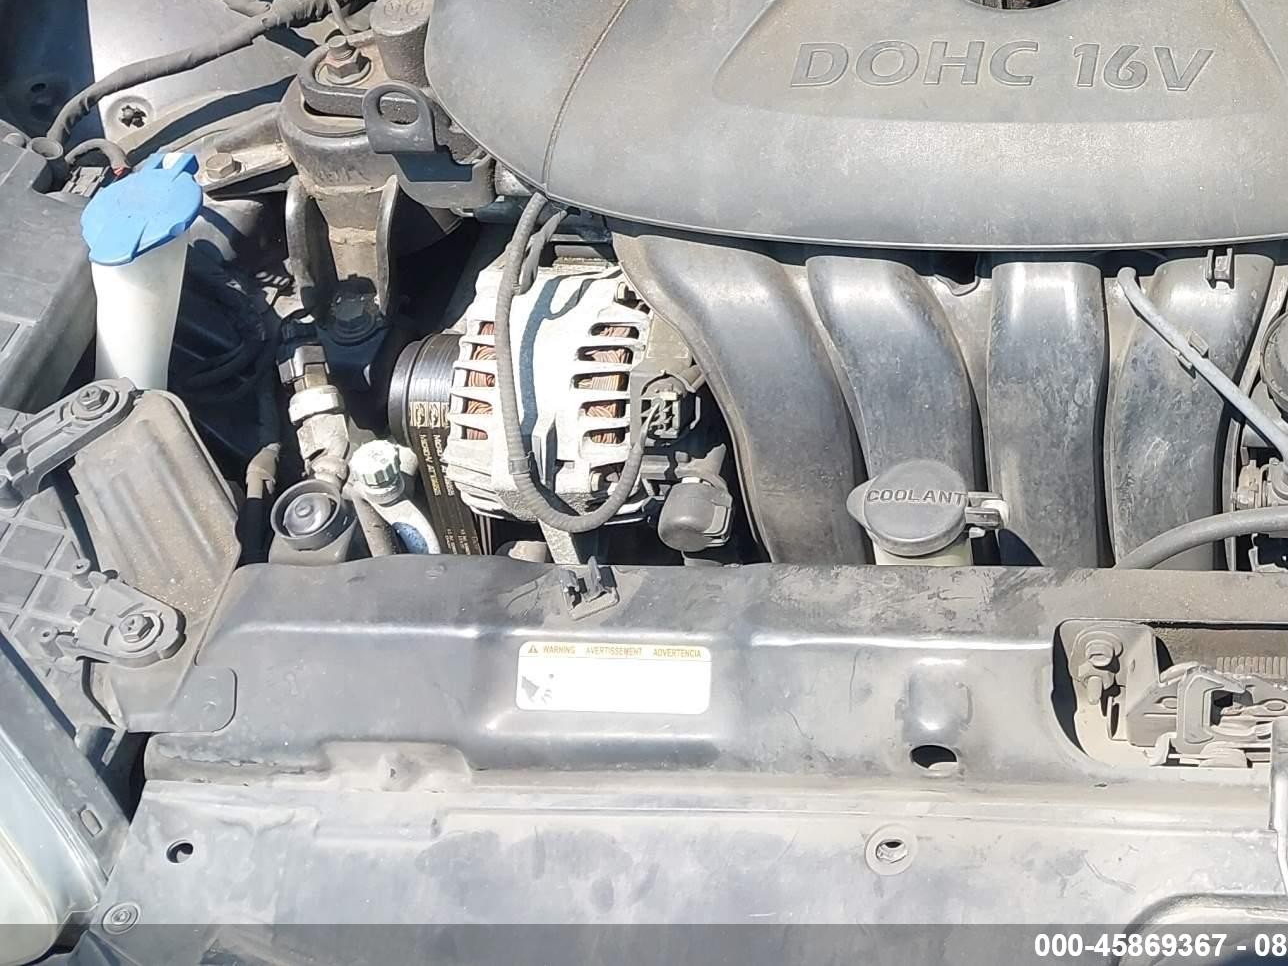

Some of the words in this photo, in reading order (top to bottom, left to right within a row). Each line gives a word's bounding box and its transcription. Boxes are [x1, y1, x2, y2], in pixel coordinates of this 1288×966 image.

[790, 40, 1039, 88] DOHC
[1072, 43, 1214, 92] 16V
[866, 488, 967, 507] COOLANT
[543, 645, 576, 655] WARNING
[586, 646, 642, 657] AVERTISSEMENT
[653, 648, 702, 659] ADVERTENCIA
